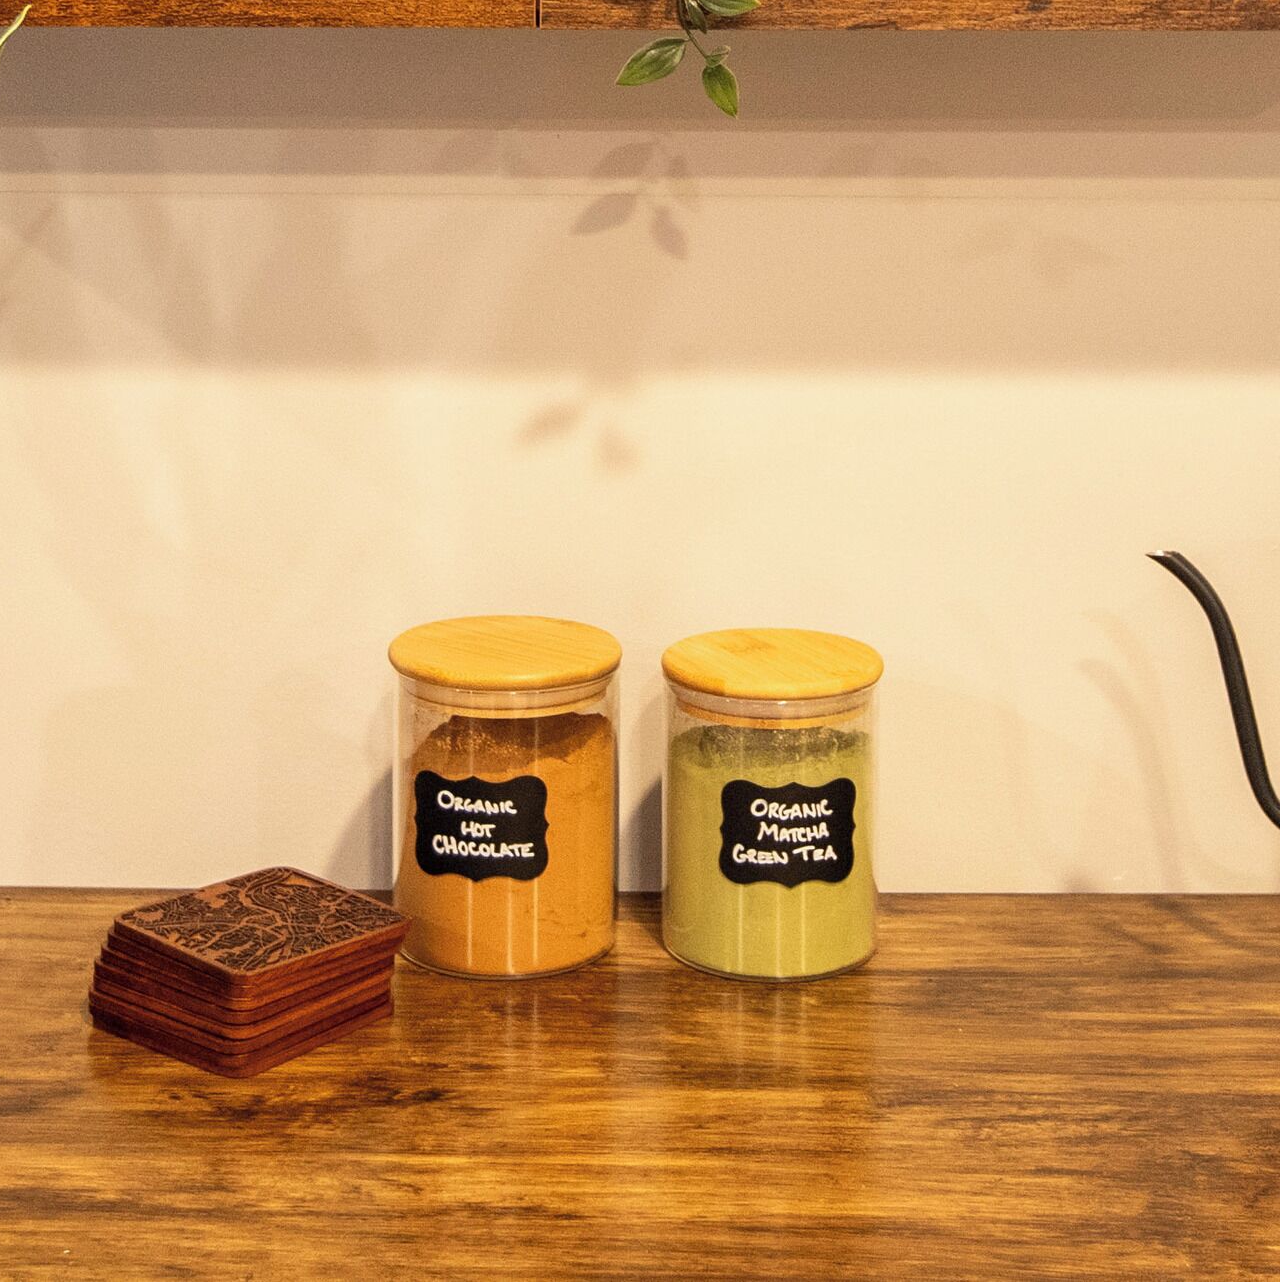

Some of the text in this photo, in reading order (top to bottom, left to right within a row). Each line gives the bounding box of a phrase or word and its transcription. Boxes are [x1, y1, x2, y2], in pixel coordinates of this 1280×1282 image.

[437, 790, 518, 815] ORGANIC
[750, 798, 834, 821] ORGANIC
[460, 820, 497, 838] HOT
[757, 821, 830, 843] MATCHA
[432, 834, 535, 858] CHOCOLATE
[732, 843, 838, 865] GREEN TEA
